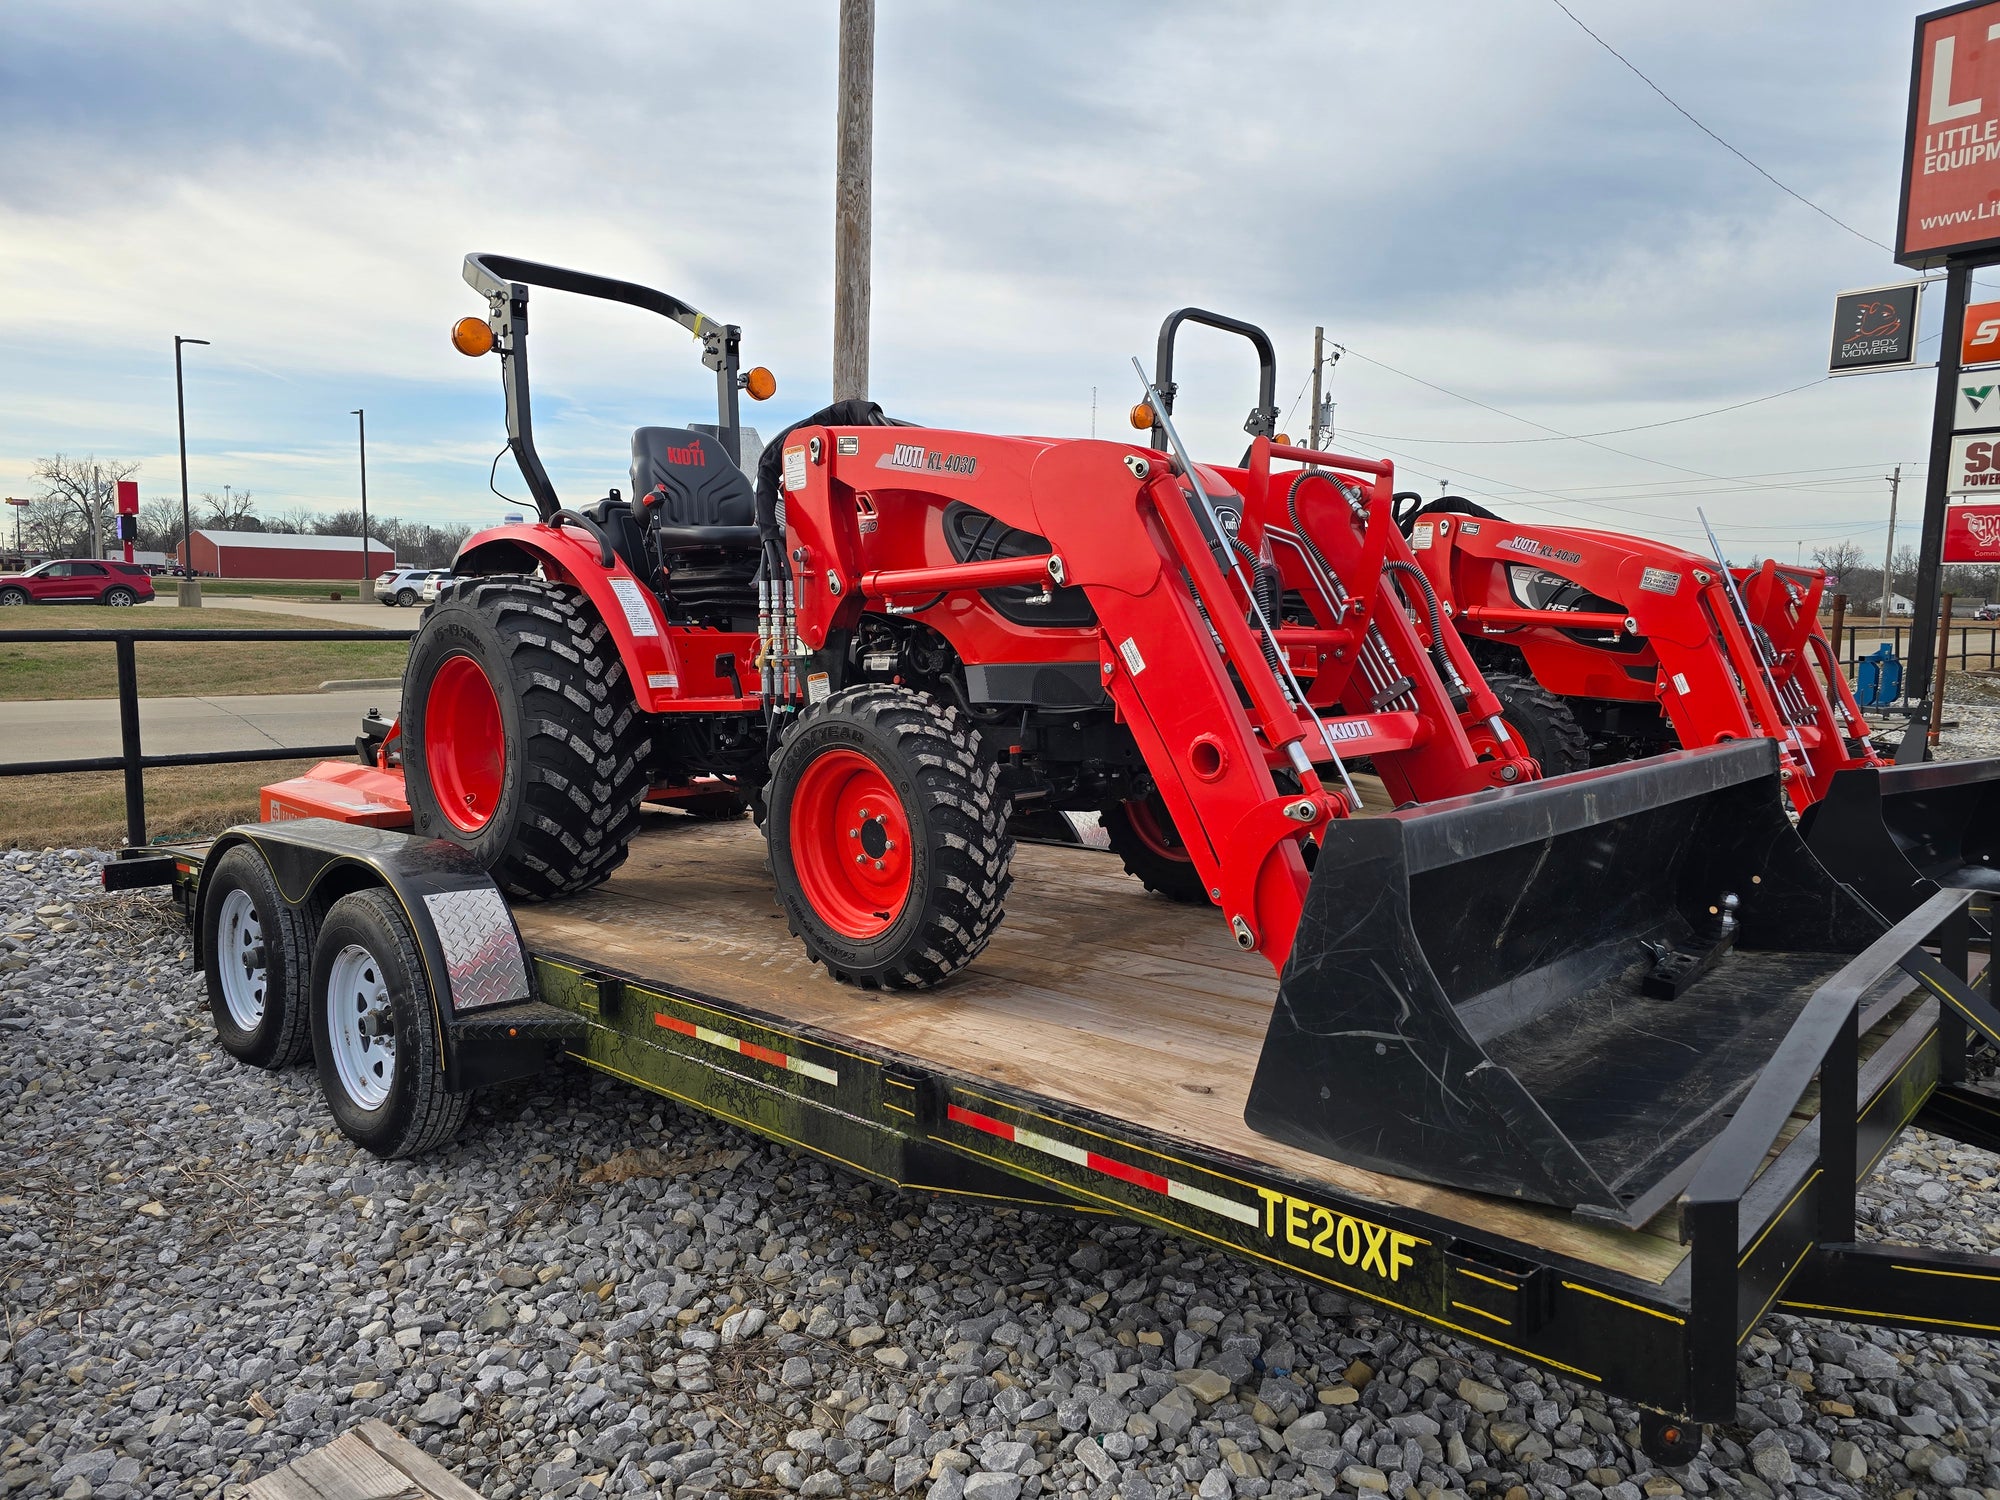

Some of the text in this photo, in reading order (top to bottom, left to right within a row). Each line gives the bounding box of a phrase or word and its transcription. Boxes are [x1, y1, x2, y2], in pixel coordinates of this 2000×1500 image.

[1928, 23, 2000, 125] L
[1925, 119, 1998, 154] LITTLE
[1841, 344, 1898, 358] MOWERS
[1842, 337, 1899, 351] BAD BOY
[667, 446, 706, 468] KIOTI
[892, 443, 977, 475] KIOTI KL 4030
[1511, 536, 1582, 564] KIOTI KL 4030
[1326, 720, 1374, 741] KIOTI
[1258, 1187, 1416, 1281] TE20XF
